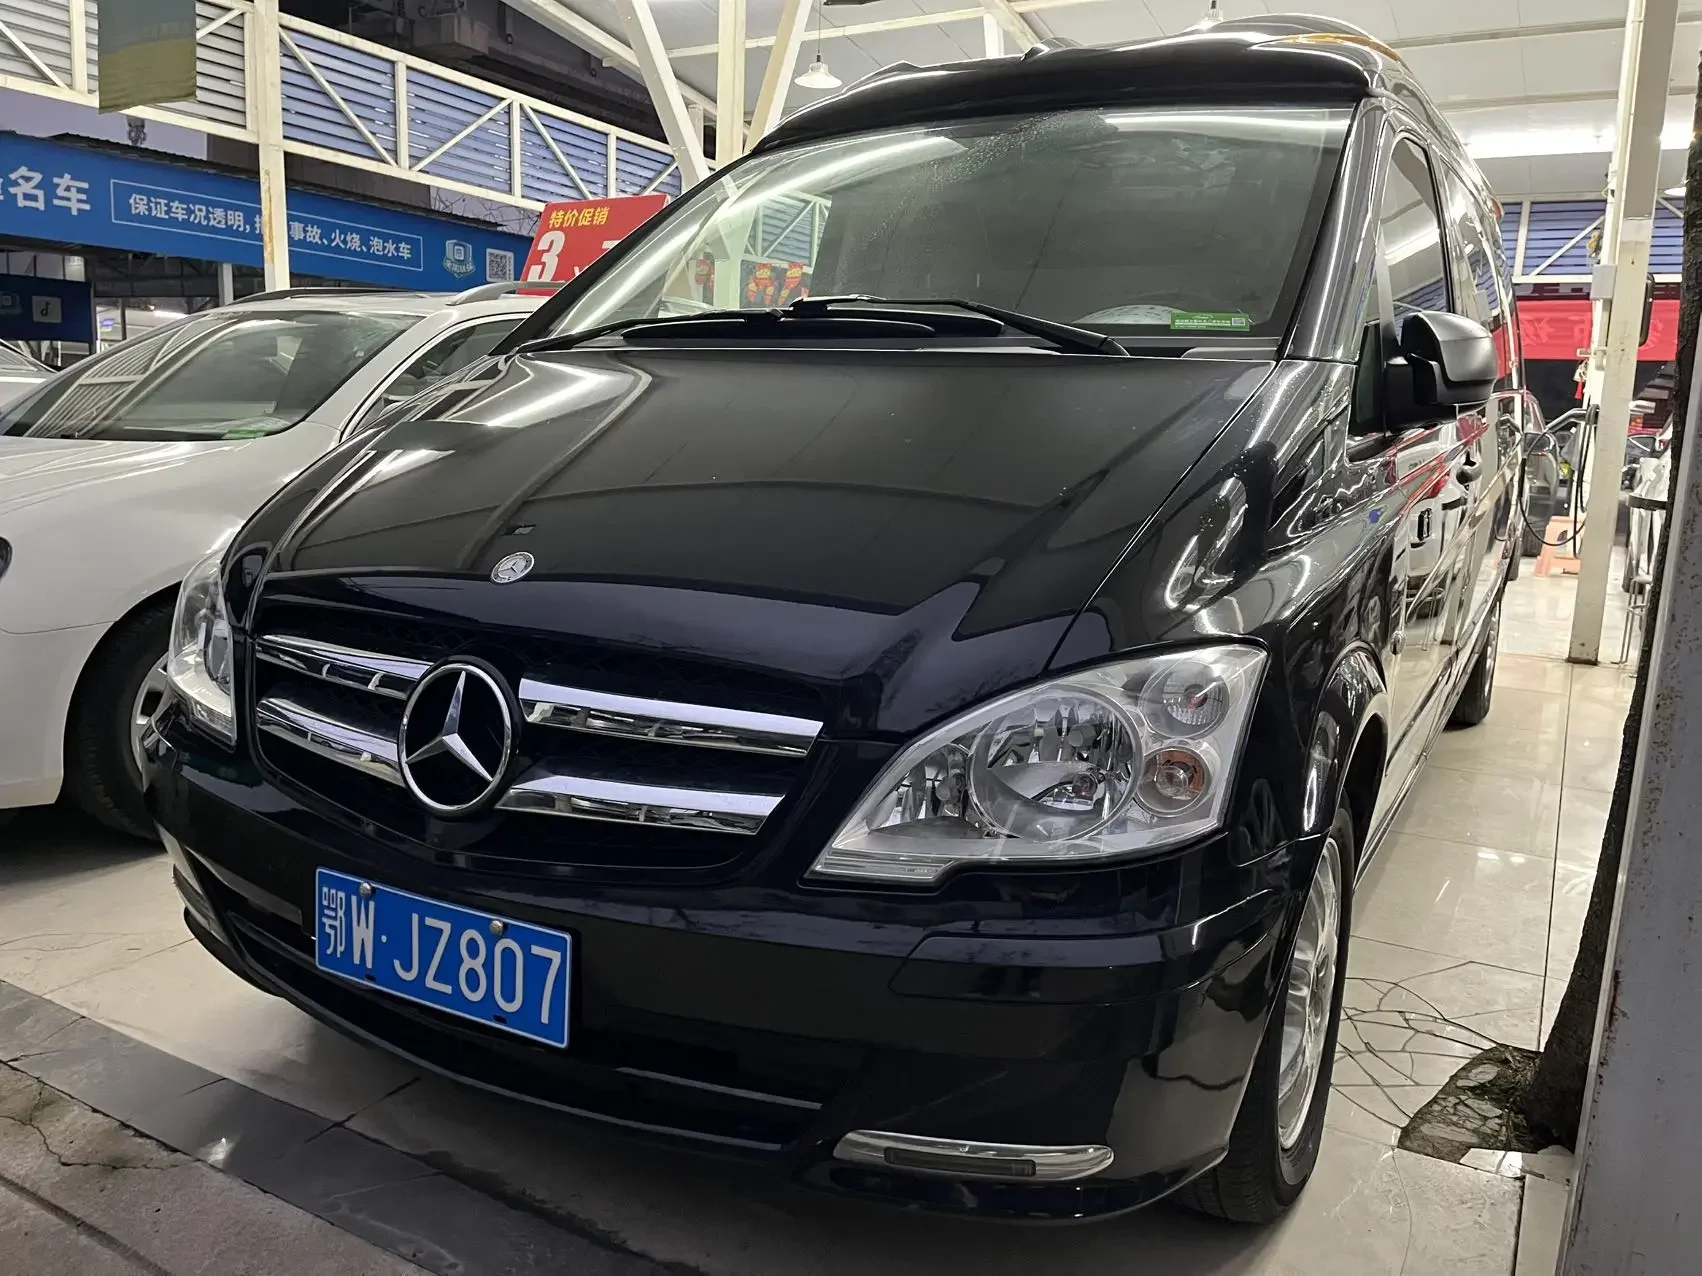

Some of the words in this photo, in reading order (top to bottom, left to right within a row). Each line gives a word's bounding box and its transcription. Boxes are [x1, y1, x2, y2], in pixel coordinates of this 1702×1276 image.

[0, 165, 91, 215] 名车
[548, 207, 610, 229] 特价促销
[322, 886, 562, 1025] 鄂W·JZ807
